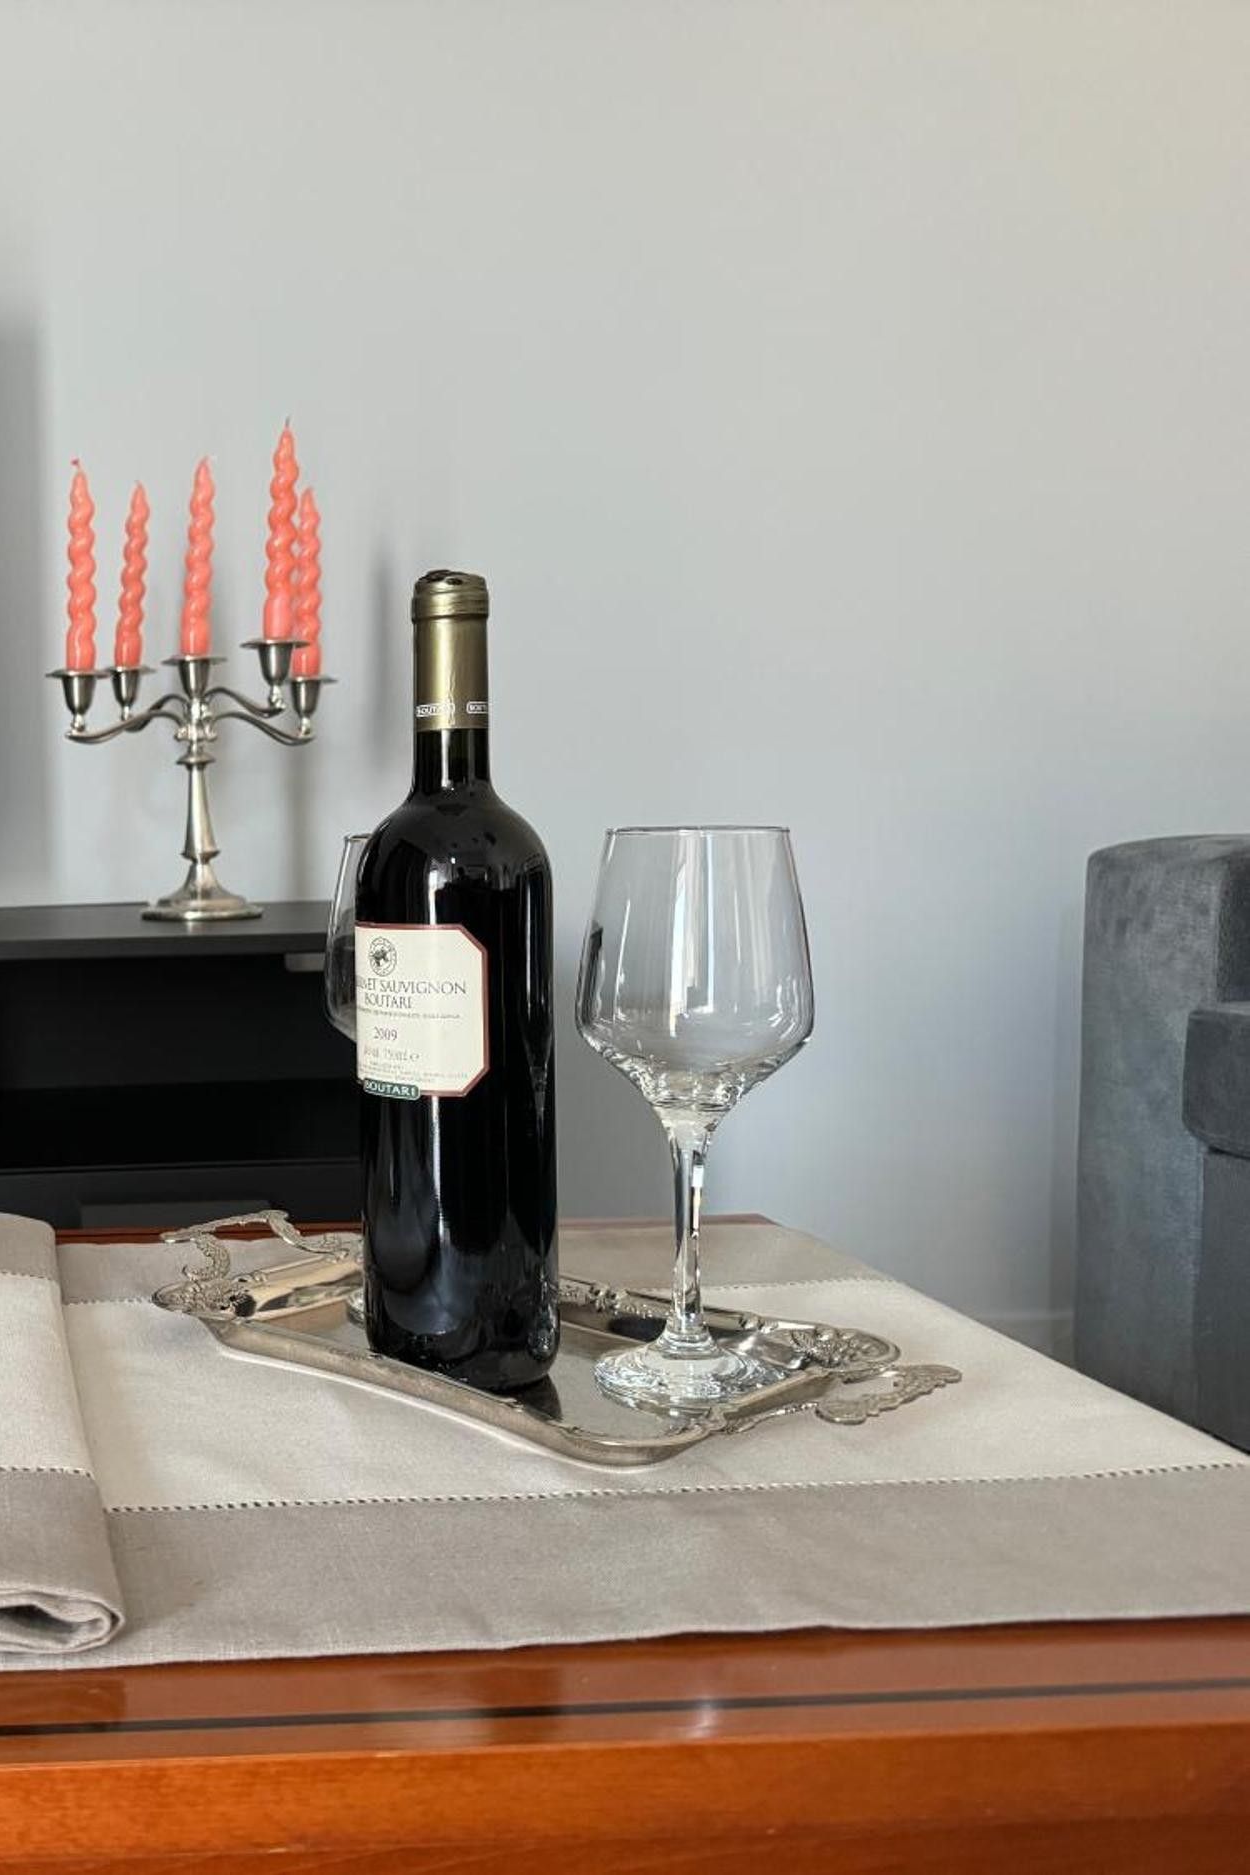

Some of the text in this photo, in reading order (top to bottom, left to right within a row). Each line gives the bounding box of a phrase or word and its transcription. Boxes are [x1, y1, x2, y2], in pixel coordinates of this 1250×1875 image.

[380, 979, 466, 994] SAUVIGNON
[365, 992, 412, 1009] BOUTARI
[365, 1080, 416, 1097] BOUTARI
